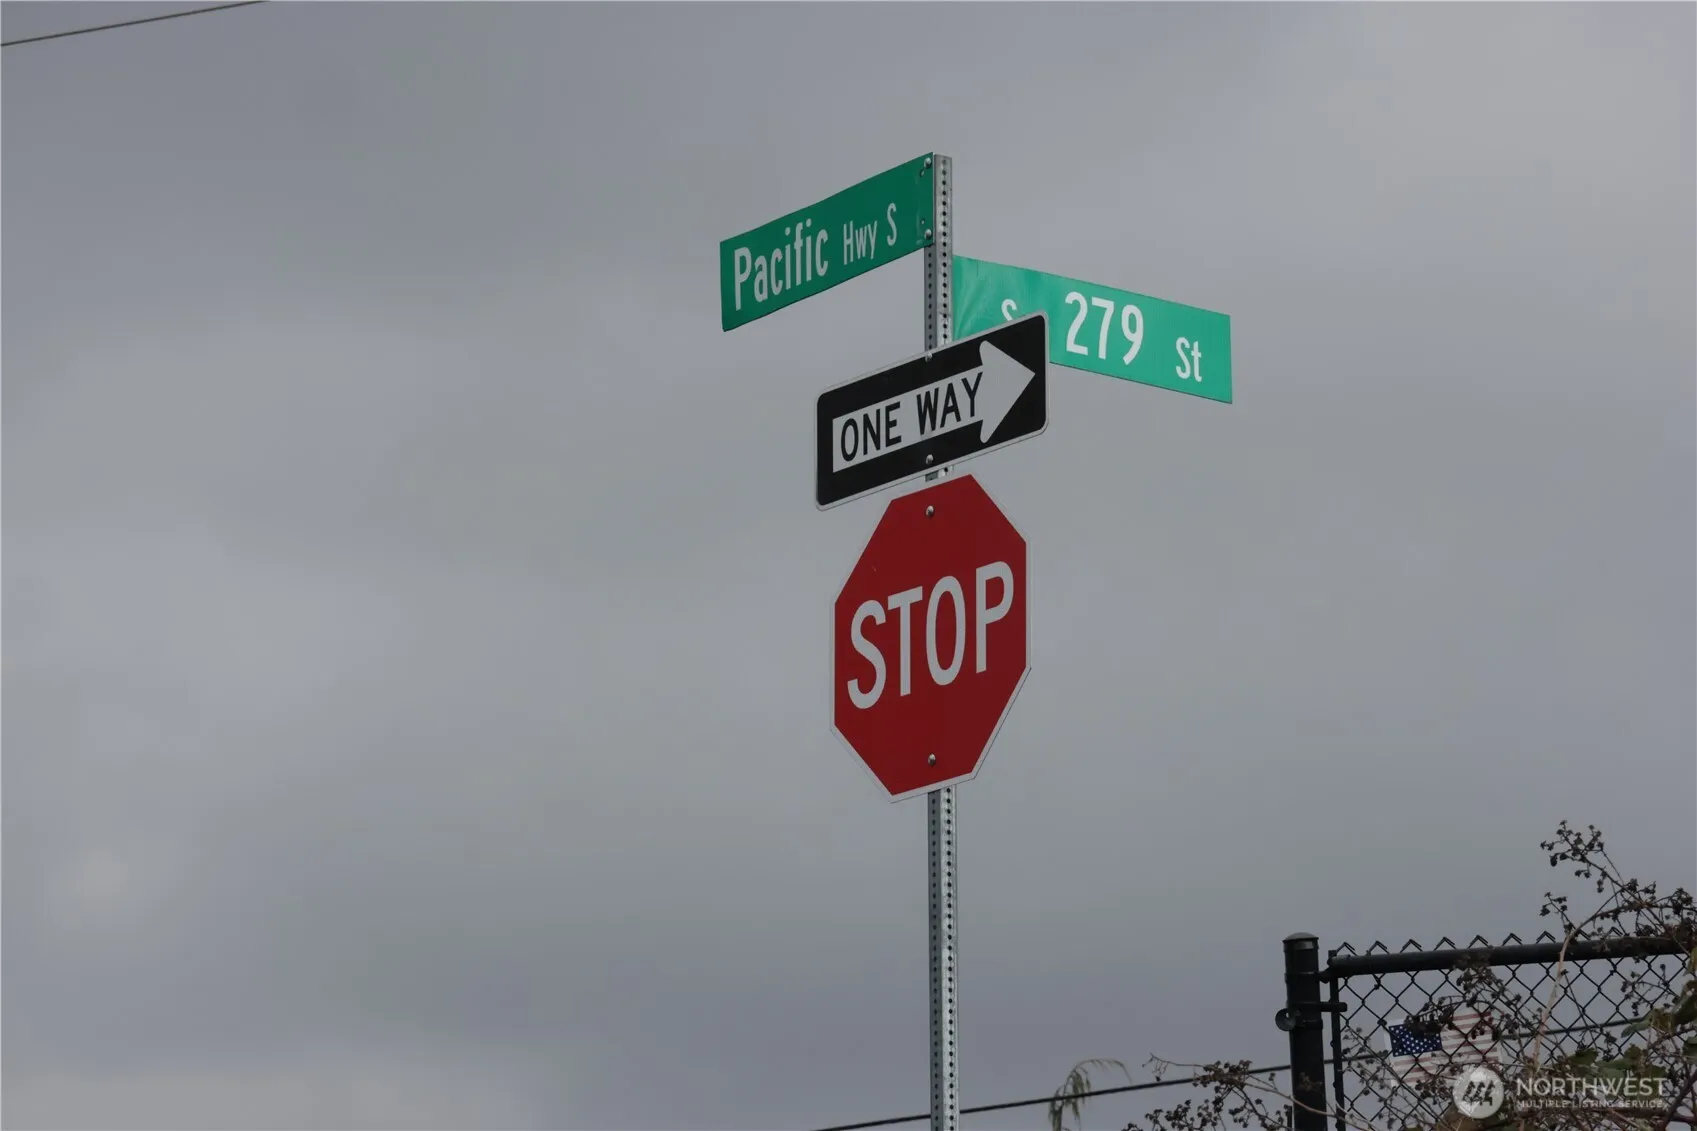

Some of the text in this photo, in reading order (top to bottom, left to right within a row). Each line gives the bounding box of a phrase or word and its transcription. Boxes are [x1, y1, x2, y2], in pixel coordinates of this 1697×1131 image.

[734, 202, 898, 311] Pacific Hwy S
[1065, 291, 1144, 365] 279
[1175, 337, 1203, 382] St
[841, 371, 983, 461] ONE WAY
[847, 561, 1014, 709] STOP
